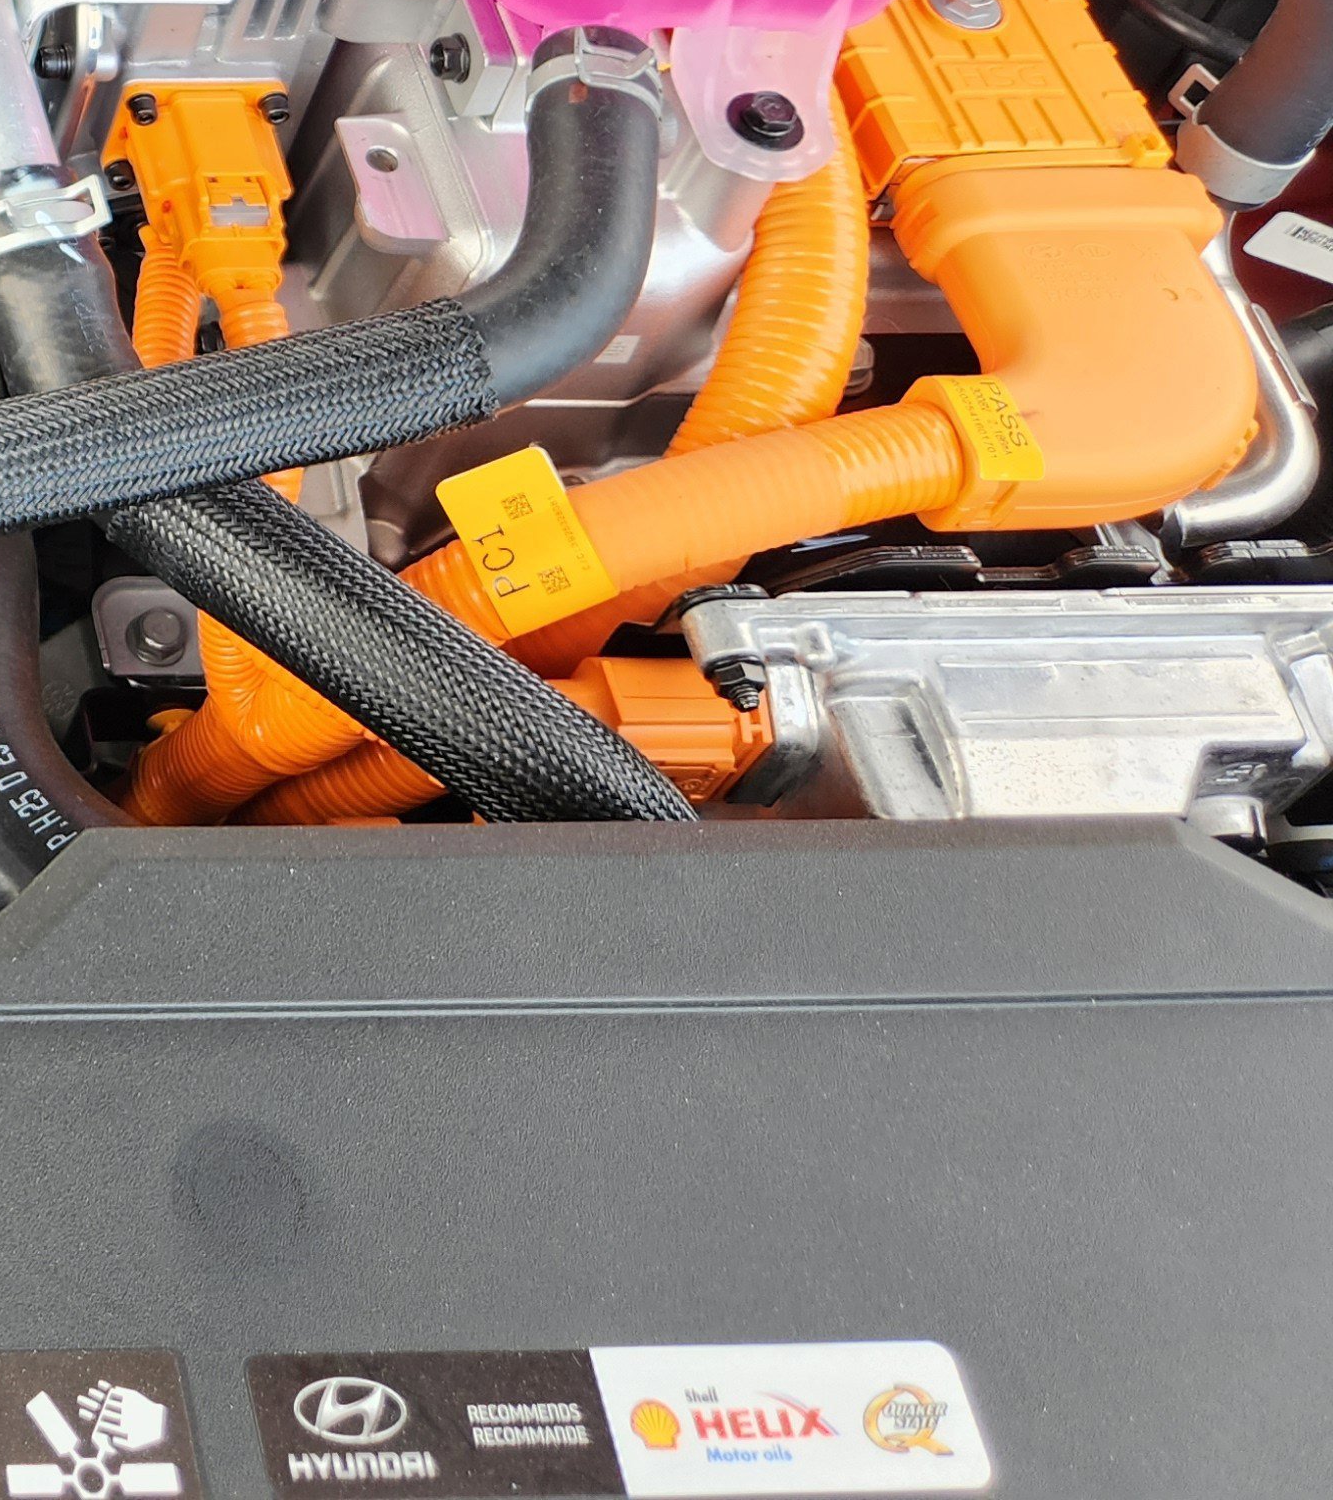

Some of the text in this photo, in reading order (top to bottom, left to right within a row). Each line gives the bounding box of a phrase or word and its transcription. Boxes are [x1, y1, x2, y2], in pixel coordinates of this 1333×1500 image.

[979, 381, 1029, 447] PASS
[472, 523, 531, 598] PC1
[685, 1386, 720, 1405] Shell
[466, 1402, 583, 1424] RECOMMENDS
[882, 1400, 950, 1419] QUAKER
[690, 1406, 835, 1440] HELIX
[892, 1414, 942, 1431] STATE
[471, 1425, 591, 1449] RECOMMANDE
[706, 1443, 794, 1464] Motor oils
[287, 1450, 440, 1482] HYUNDAI
